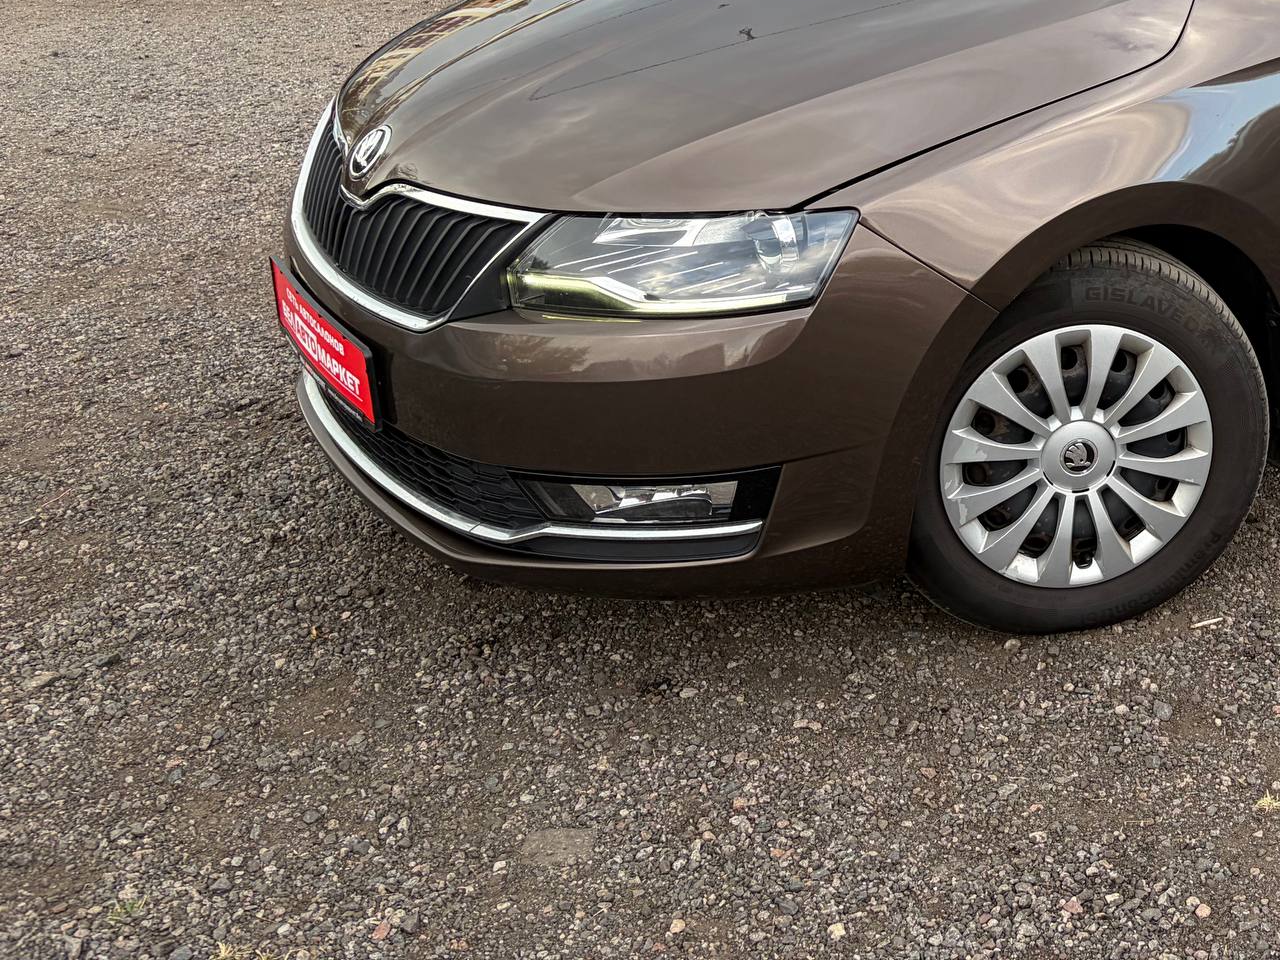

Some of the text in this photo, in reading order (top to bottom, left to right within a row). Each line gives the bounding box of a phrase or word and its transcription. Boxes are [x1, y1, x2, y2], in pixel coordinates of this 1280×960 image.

[282, 299, 361, 395] БЕЛ АВТО МАРКЕТ
[286, 287, 299, 310] СЕТЬ
[300, 304, 345, 356] АВТОСАЛОНОВ
